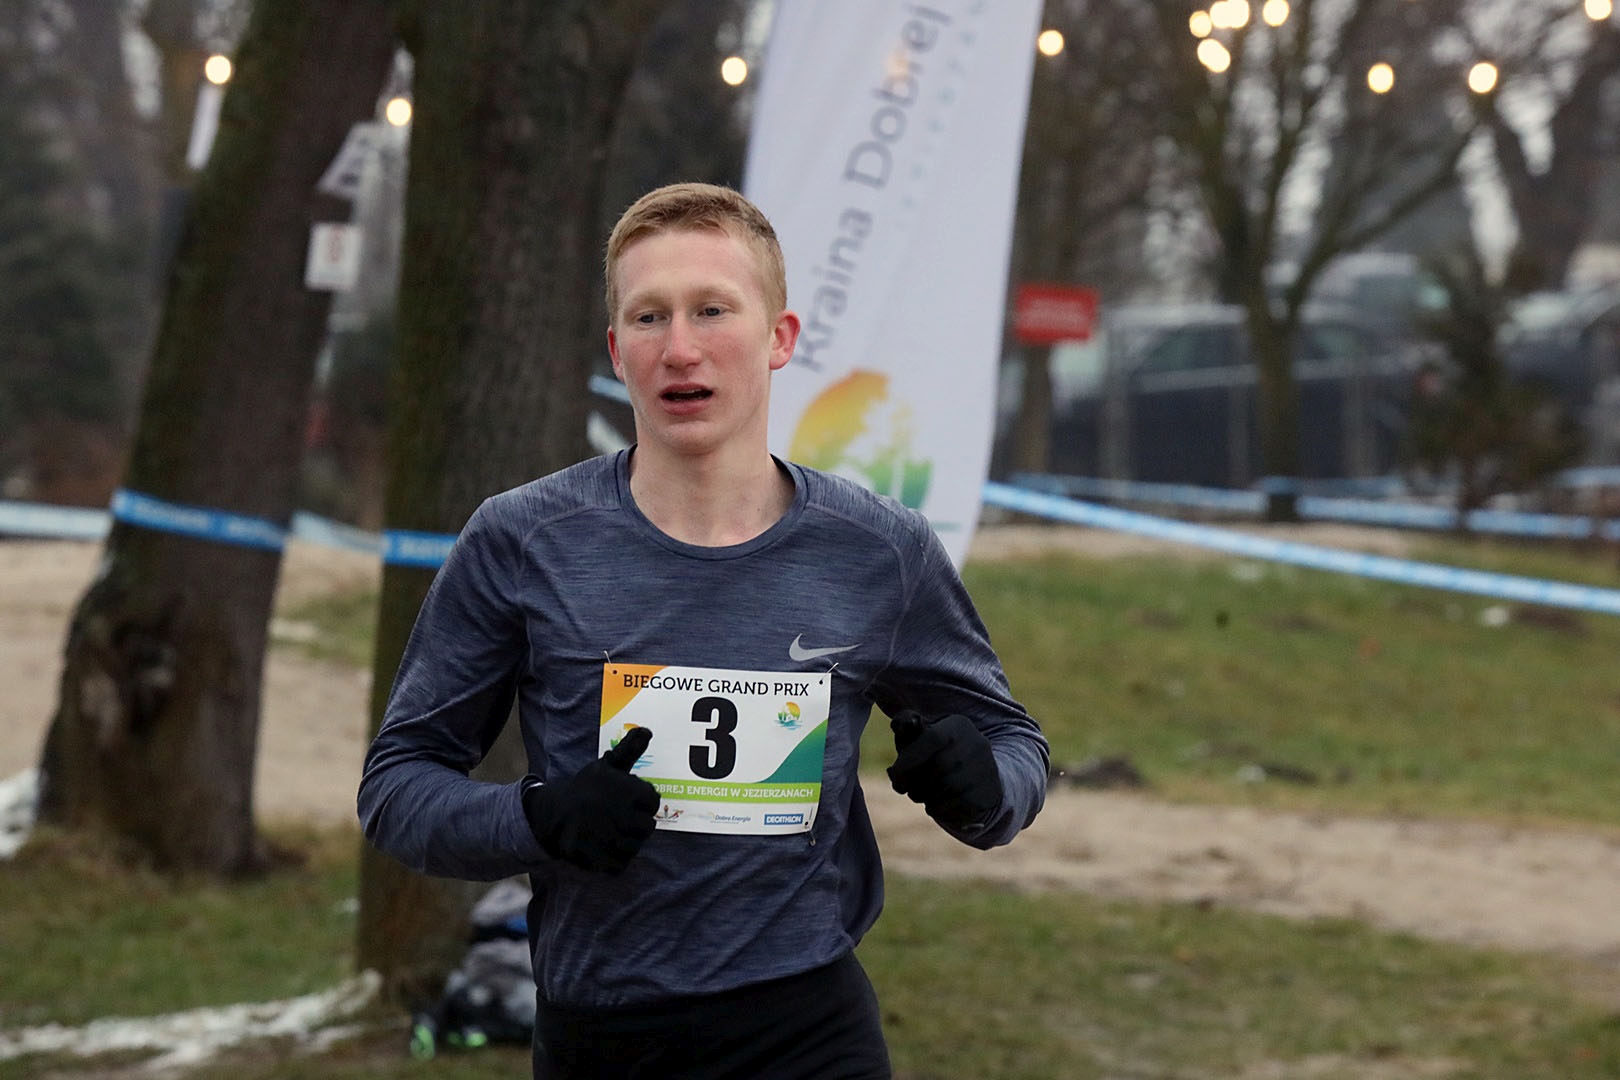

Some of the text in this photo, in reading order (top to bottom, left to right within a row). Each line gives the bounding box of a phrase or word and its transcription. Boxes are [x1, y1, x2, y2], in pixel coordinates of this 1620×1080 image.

[792, 207, 874, 373] Kraina
[844, 1, 954, 189] Dobrej
[623, 674, 809, 697] BIEGOWE GRAND PRIX
[688, 696, 739, 780] 3
[652, 783, 814, 798] OBREJ ENERGII W JEZIERZANACH
[766, 815, 802, 824] DECATHLON
